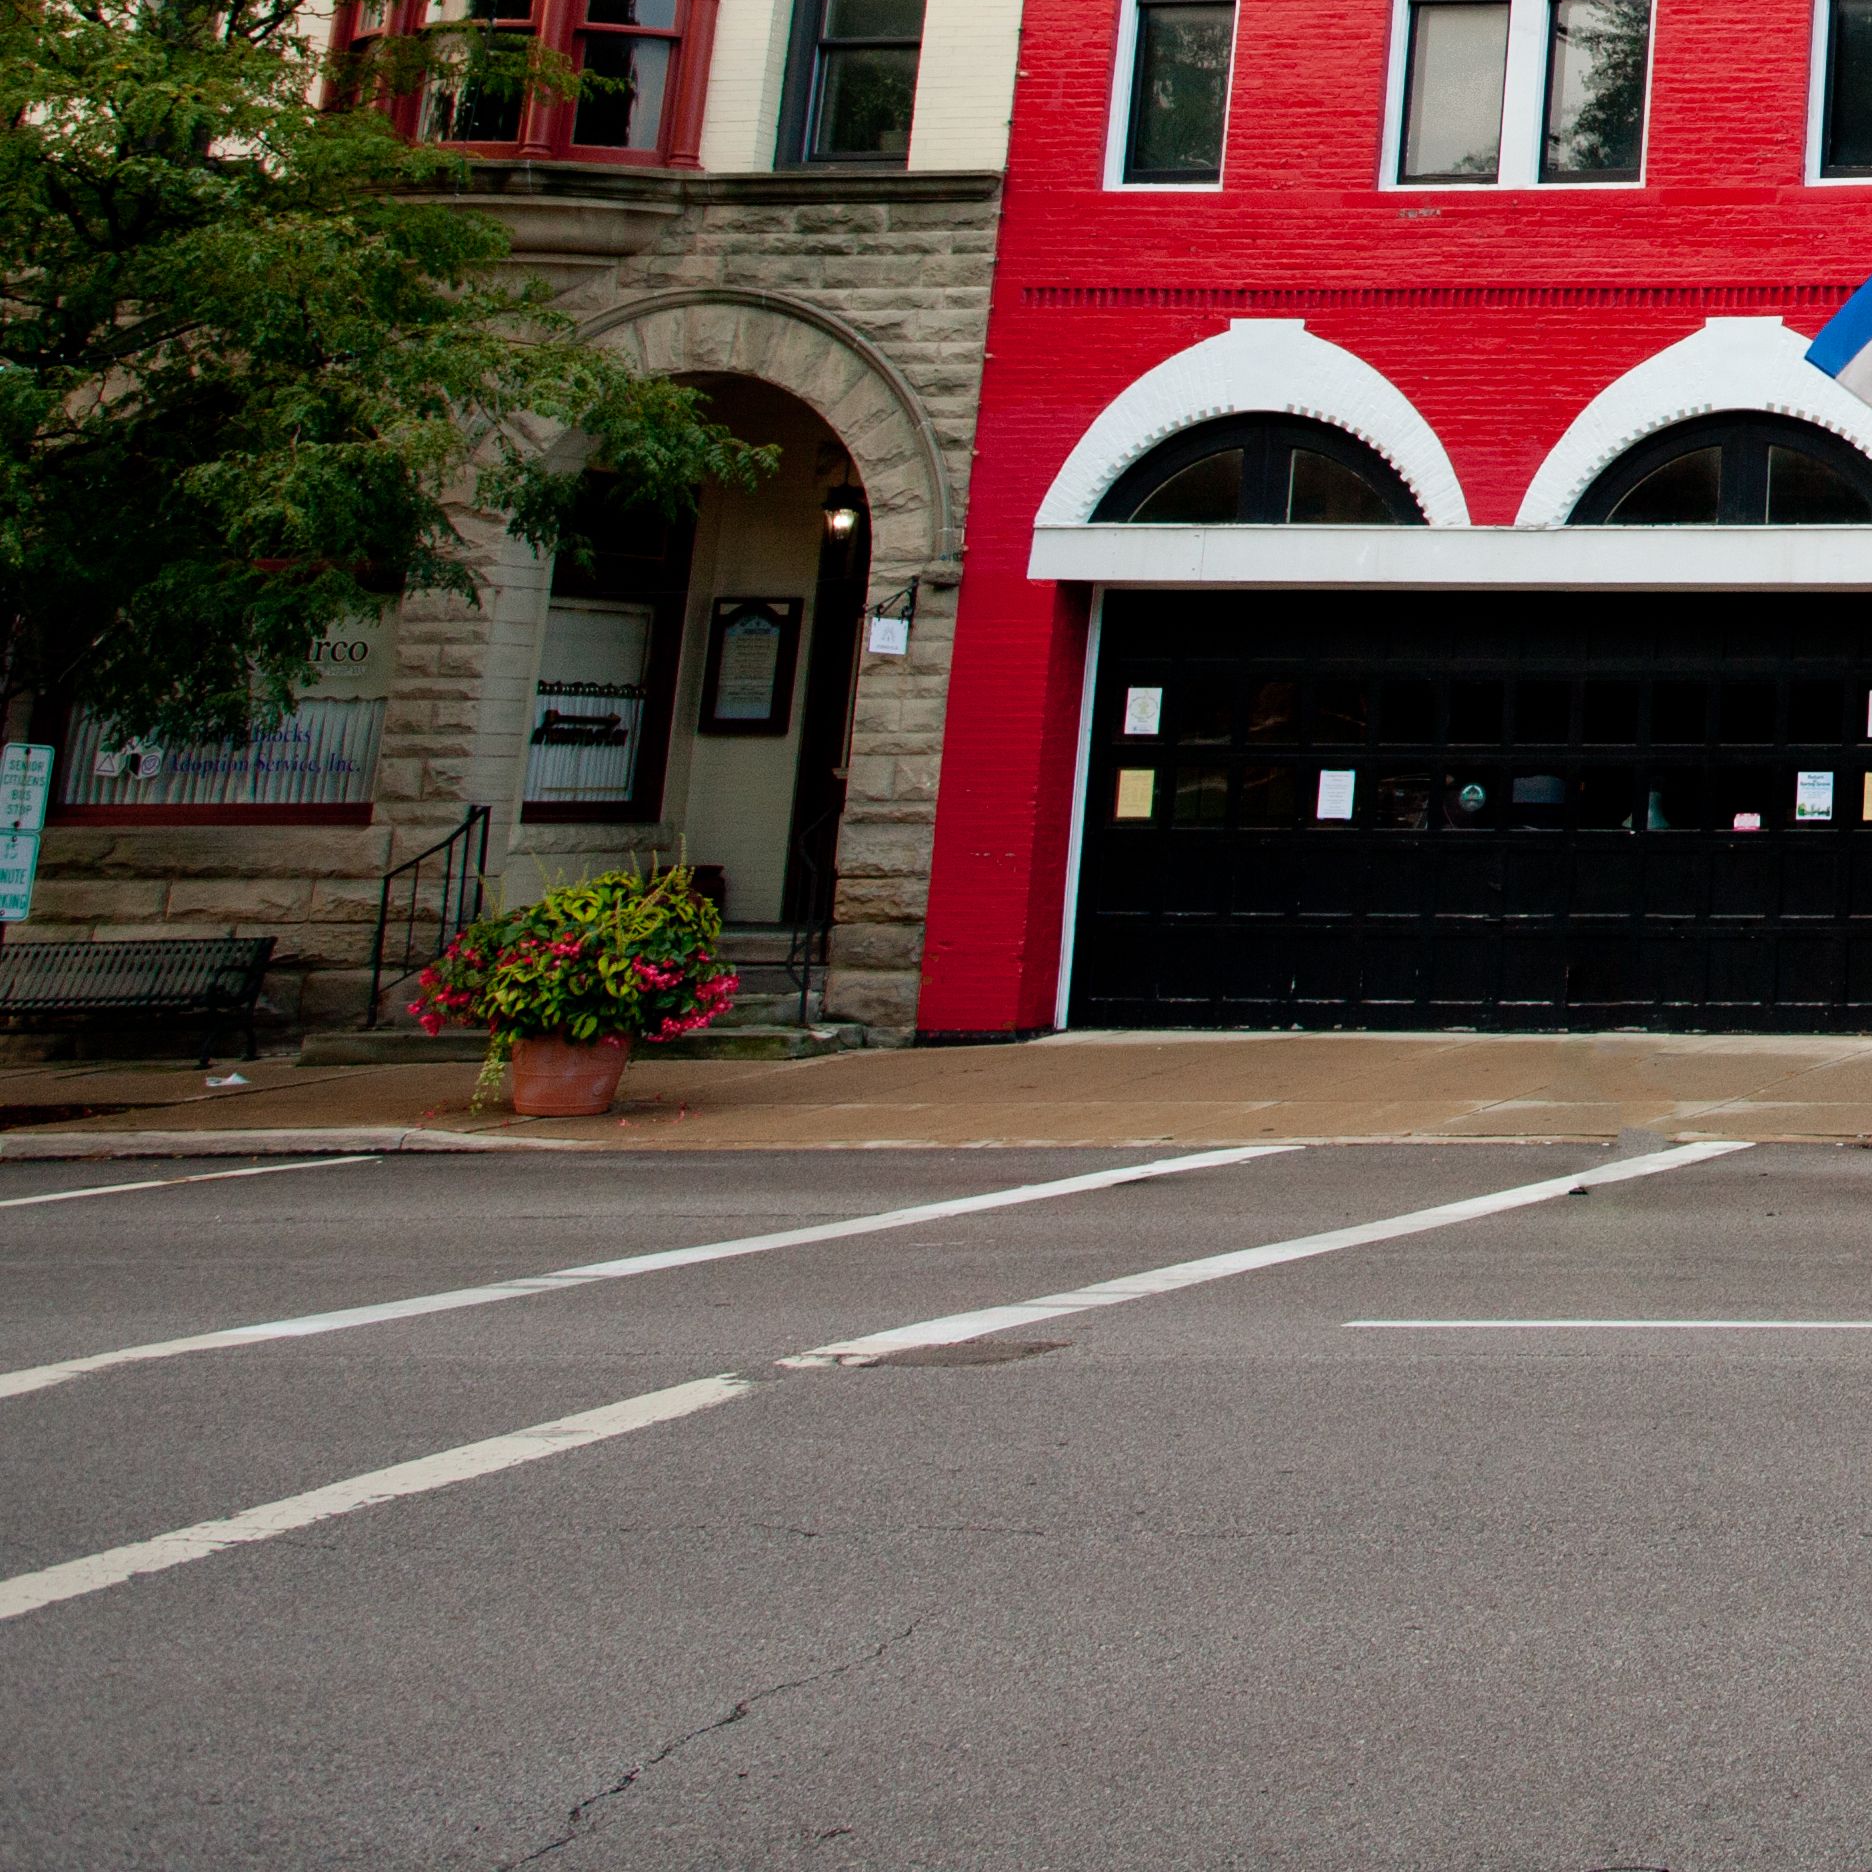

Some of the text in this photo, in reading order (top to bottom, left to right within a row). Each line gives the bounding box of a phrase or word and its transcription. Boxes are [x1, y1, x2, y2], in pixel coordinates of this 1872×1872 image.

[8, 760, 44, 772] SENIOR
[171, 752, 248, 778] Adoption
[328, 752, 361, 773] Inc.
[3, 775, 46, 787] CITIZENS
[11, 790, 32, 801] BUS
[6, 805, 33, 817] STOP
[0, 868, 26, 885] NUTE
[0, 894, 27, 909] KING
